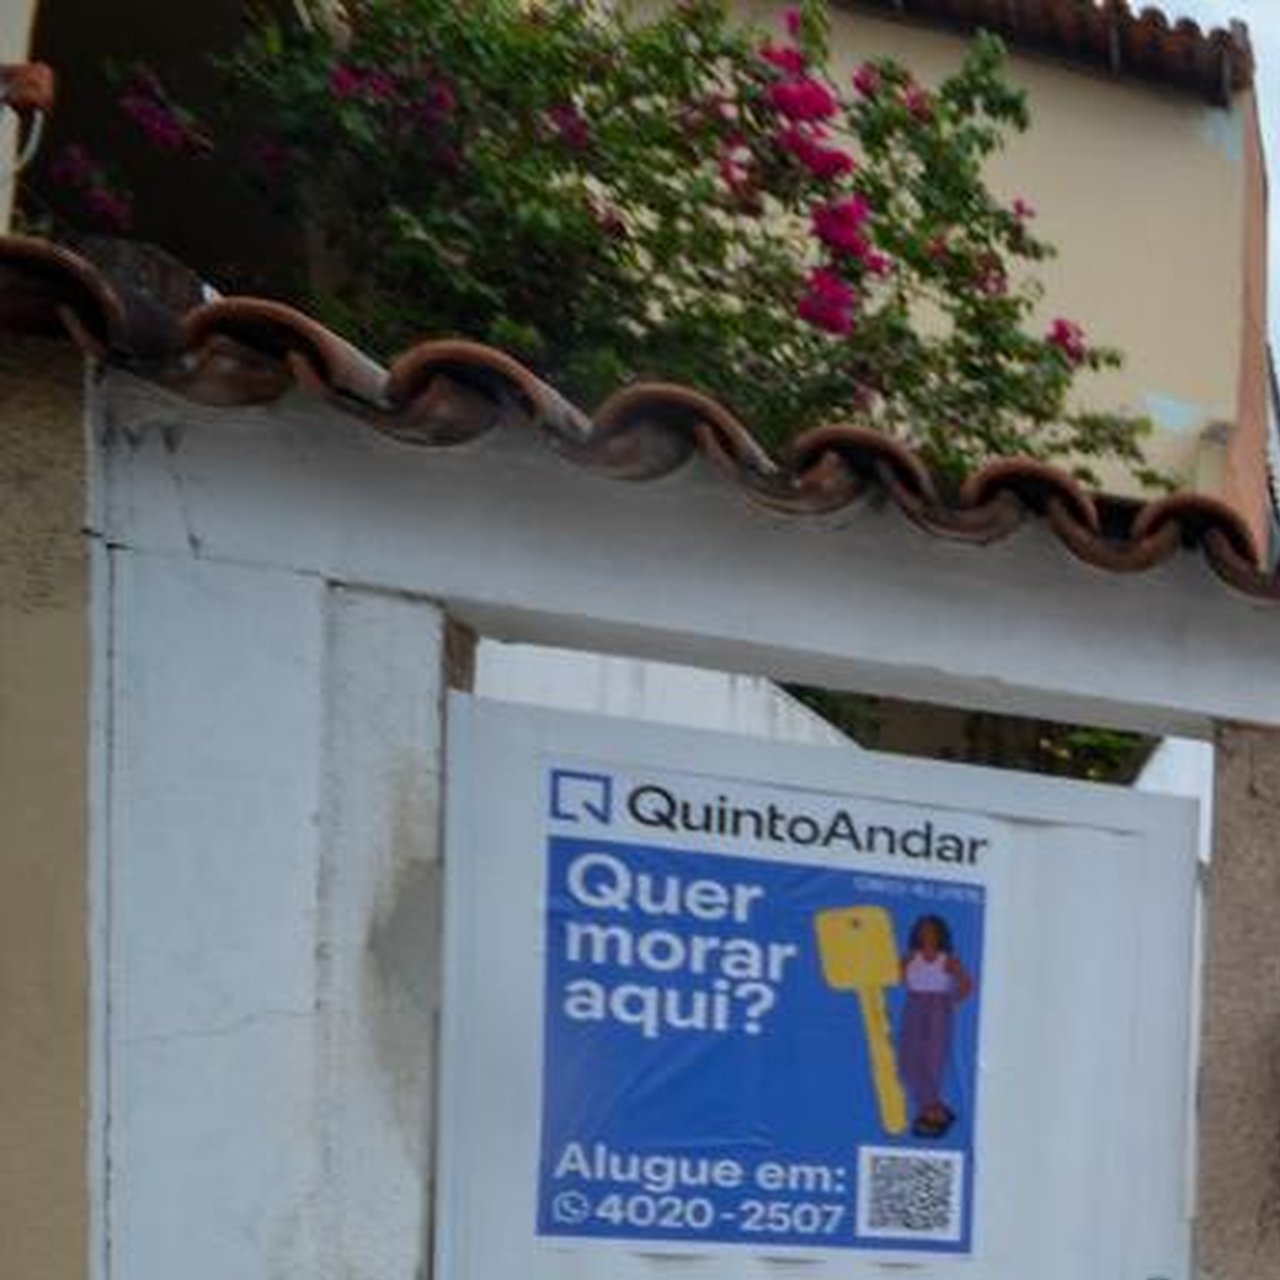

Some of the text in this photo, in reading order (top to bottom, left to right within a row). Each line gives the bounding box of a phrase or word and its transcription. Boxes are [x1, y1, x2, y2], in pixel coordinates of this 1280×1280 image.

[626, 785, 988, 865] QuintoAndar
[567, 853, 763, 922] Quer
[565, 921, 798, 982] morar
[564, 979, 774, 1035] aqui?
[553, 1142, 846, 1192] Alugue em:
